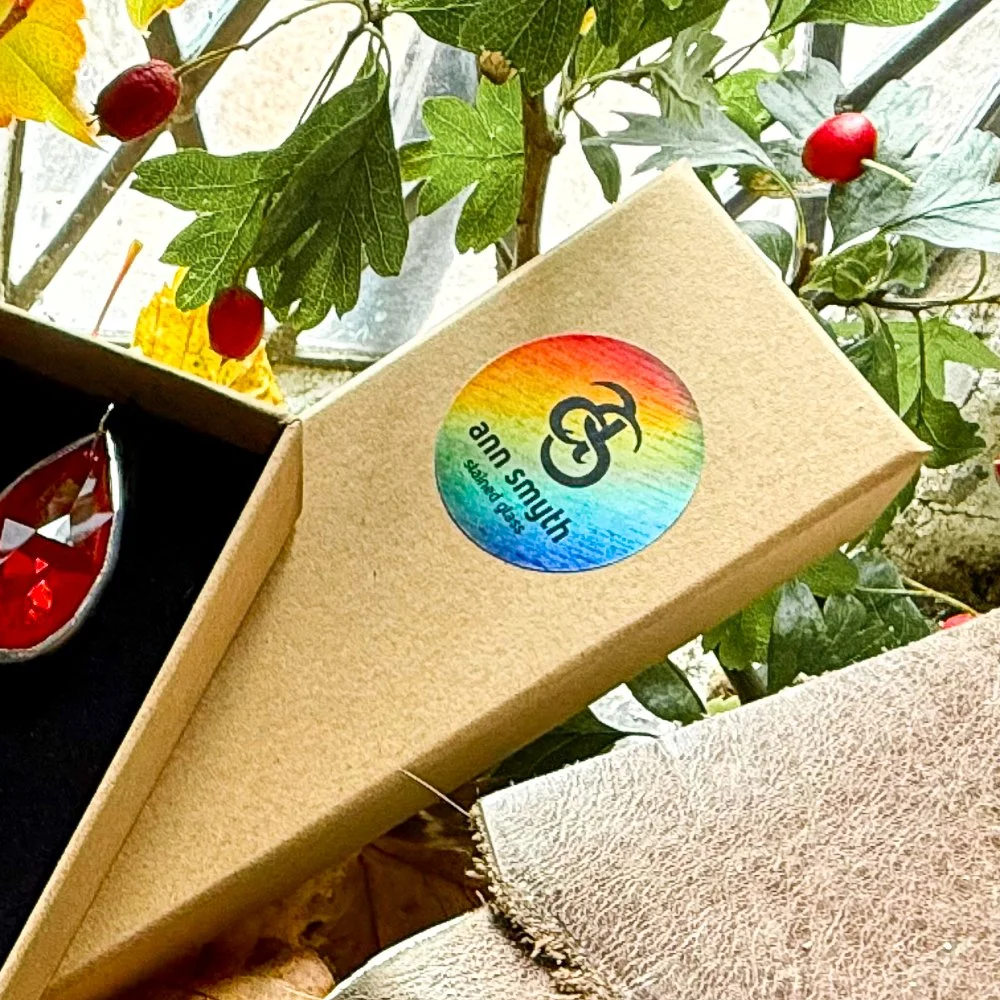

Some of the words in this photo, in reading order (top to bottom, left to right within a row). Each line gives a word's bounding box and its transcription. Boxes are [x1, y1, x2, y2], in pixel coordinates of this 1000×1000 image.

[463, 459, 504, 503] stained
[493, 502, 526, 535] glass
[468, 421, 512, 469] ann
[504, 468, 573, 544] smyth
